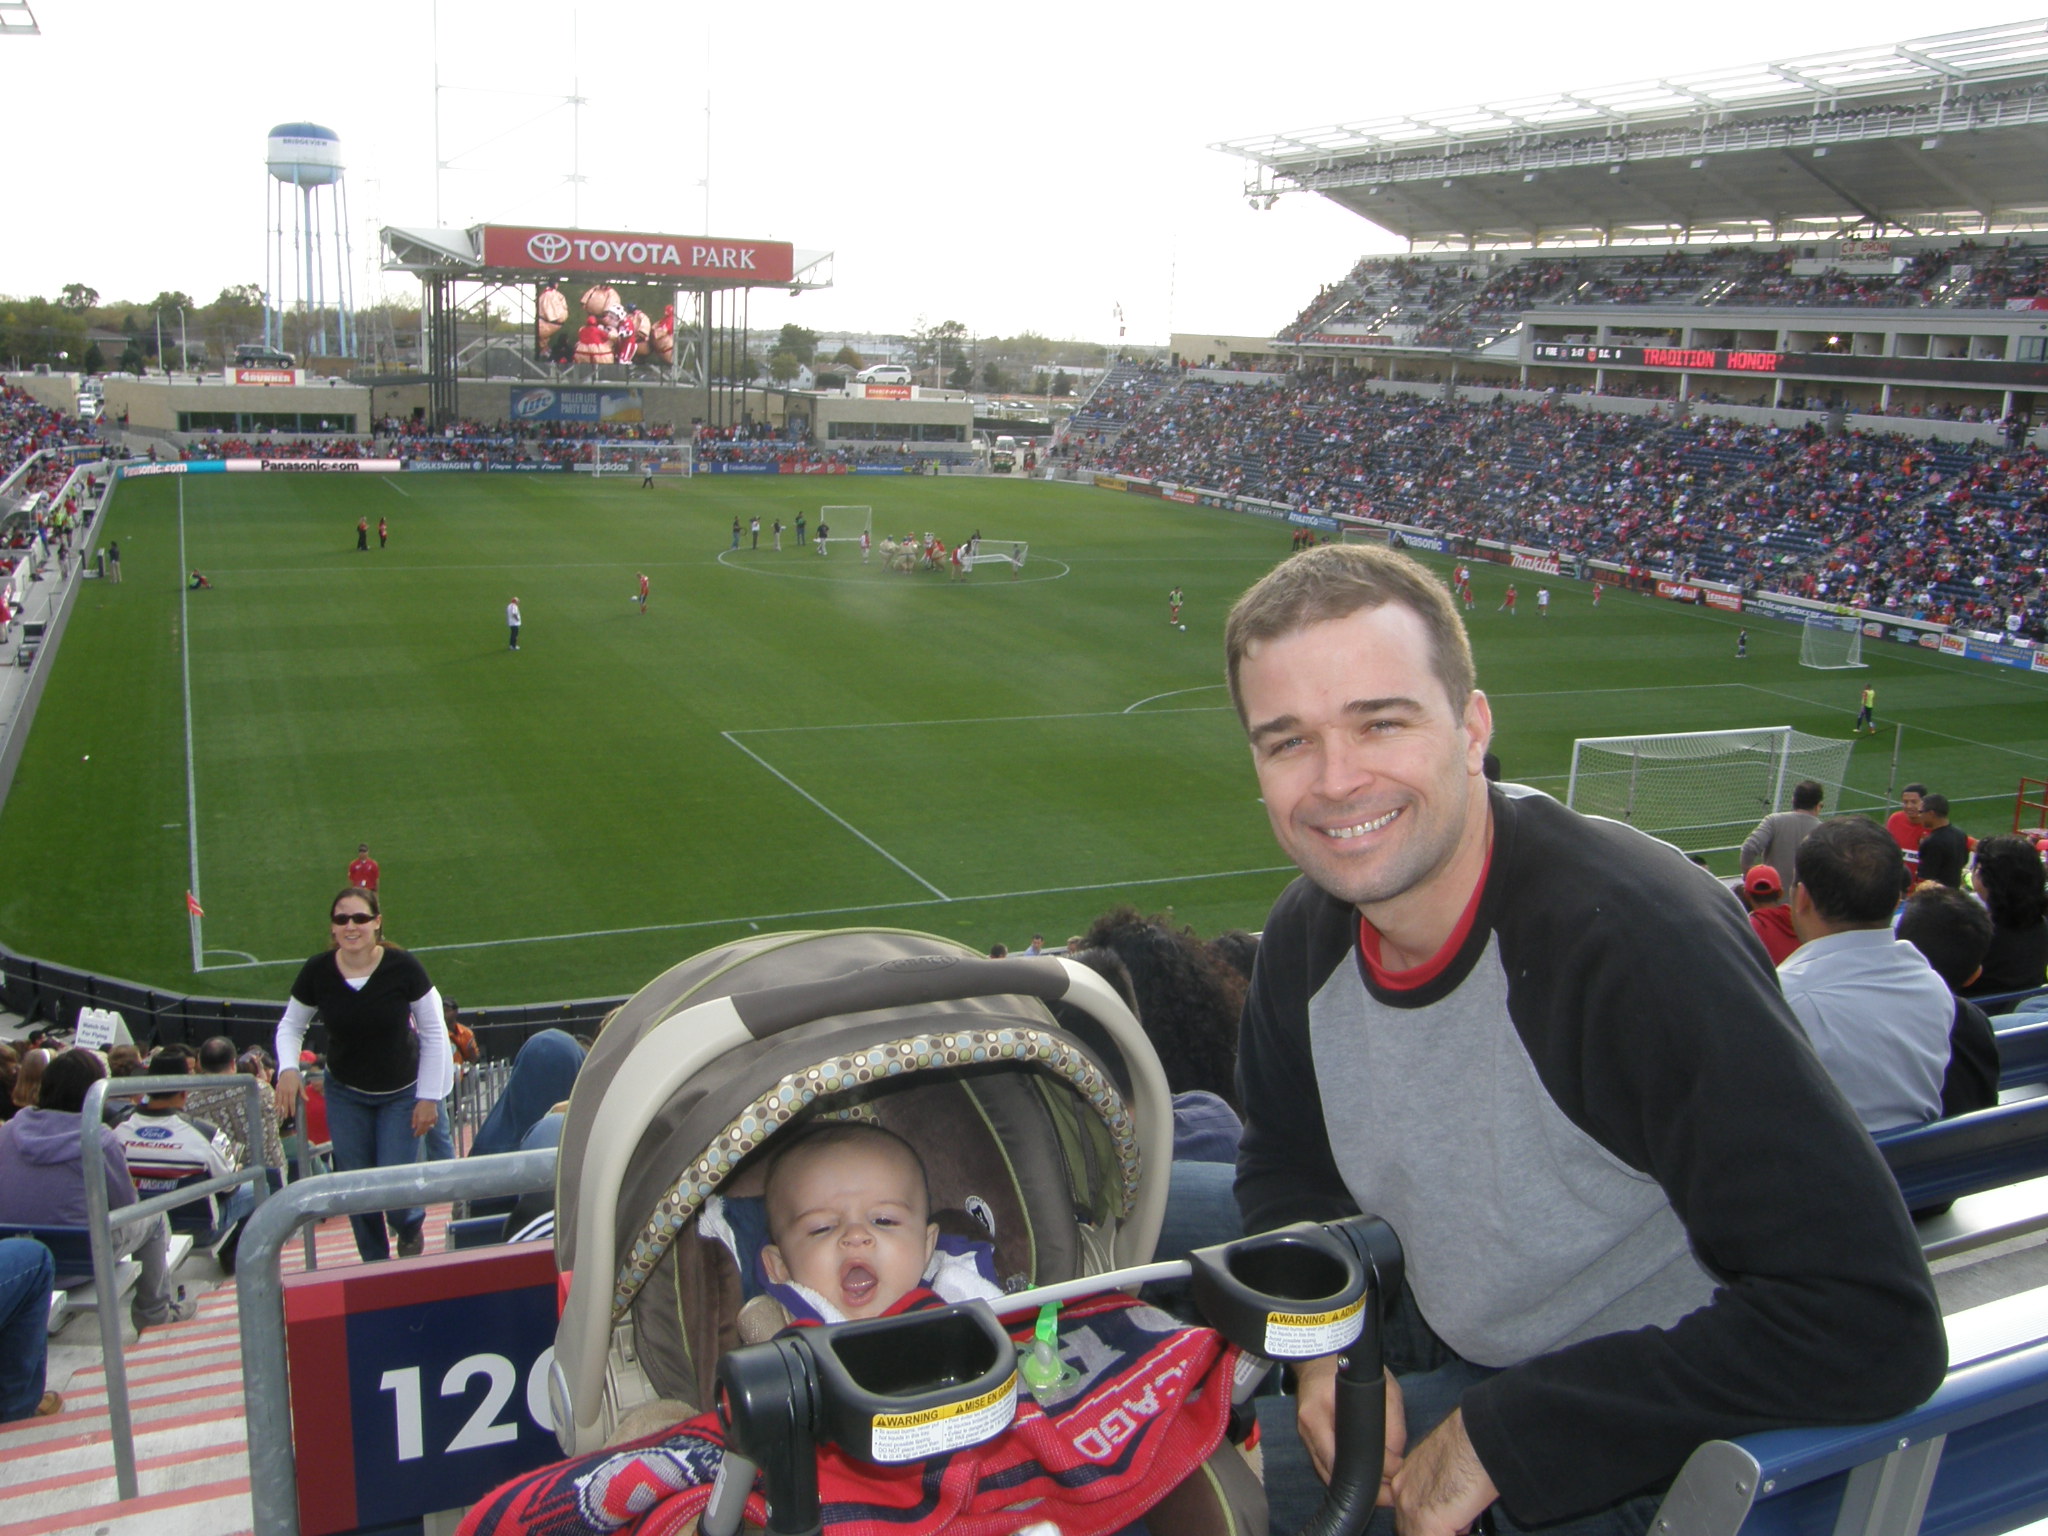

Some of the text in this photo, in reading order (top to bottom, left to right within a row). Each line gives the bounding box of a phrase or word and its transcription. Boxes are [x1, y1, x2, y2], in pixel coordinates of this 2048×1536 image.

[282, 138, 328, 147] BRIDGEVIEW
[574, 239, 756, 270] TOYOTA PARK
[1643, 348, 1776, 371] TRADITION HONOR
[561, 392, 597, 403] MILLER LITE
[561, 404, 597, 415] PARTY DECK
[260, 460, 360, 472] Panasonic.com
[416, 461, 470, 470] VOLKSWAGEN
[595, 462, 629, 472] adidas
[1510, 552, 1560, 574] Makita
[1942, 635, 1964, 652] Hoy
[141, 1129, 165, 1138] Ford
[124, 1140, 184, 1150] RACING
[138, 1178, 179, 1190] NASCAR
[1279, 1314, 1326, 1325] WARNING
[886, 1410, 939, 1426] WARNING
[964, 1397, 985, 1412] MISE
[987, 1391, 997, 1404] EN
